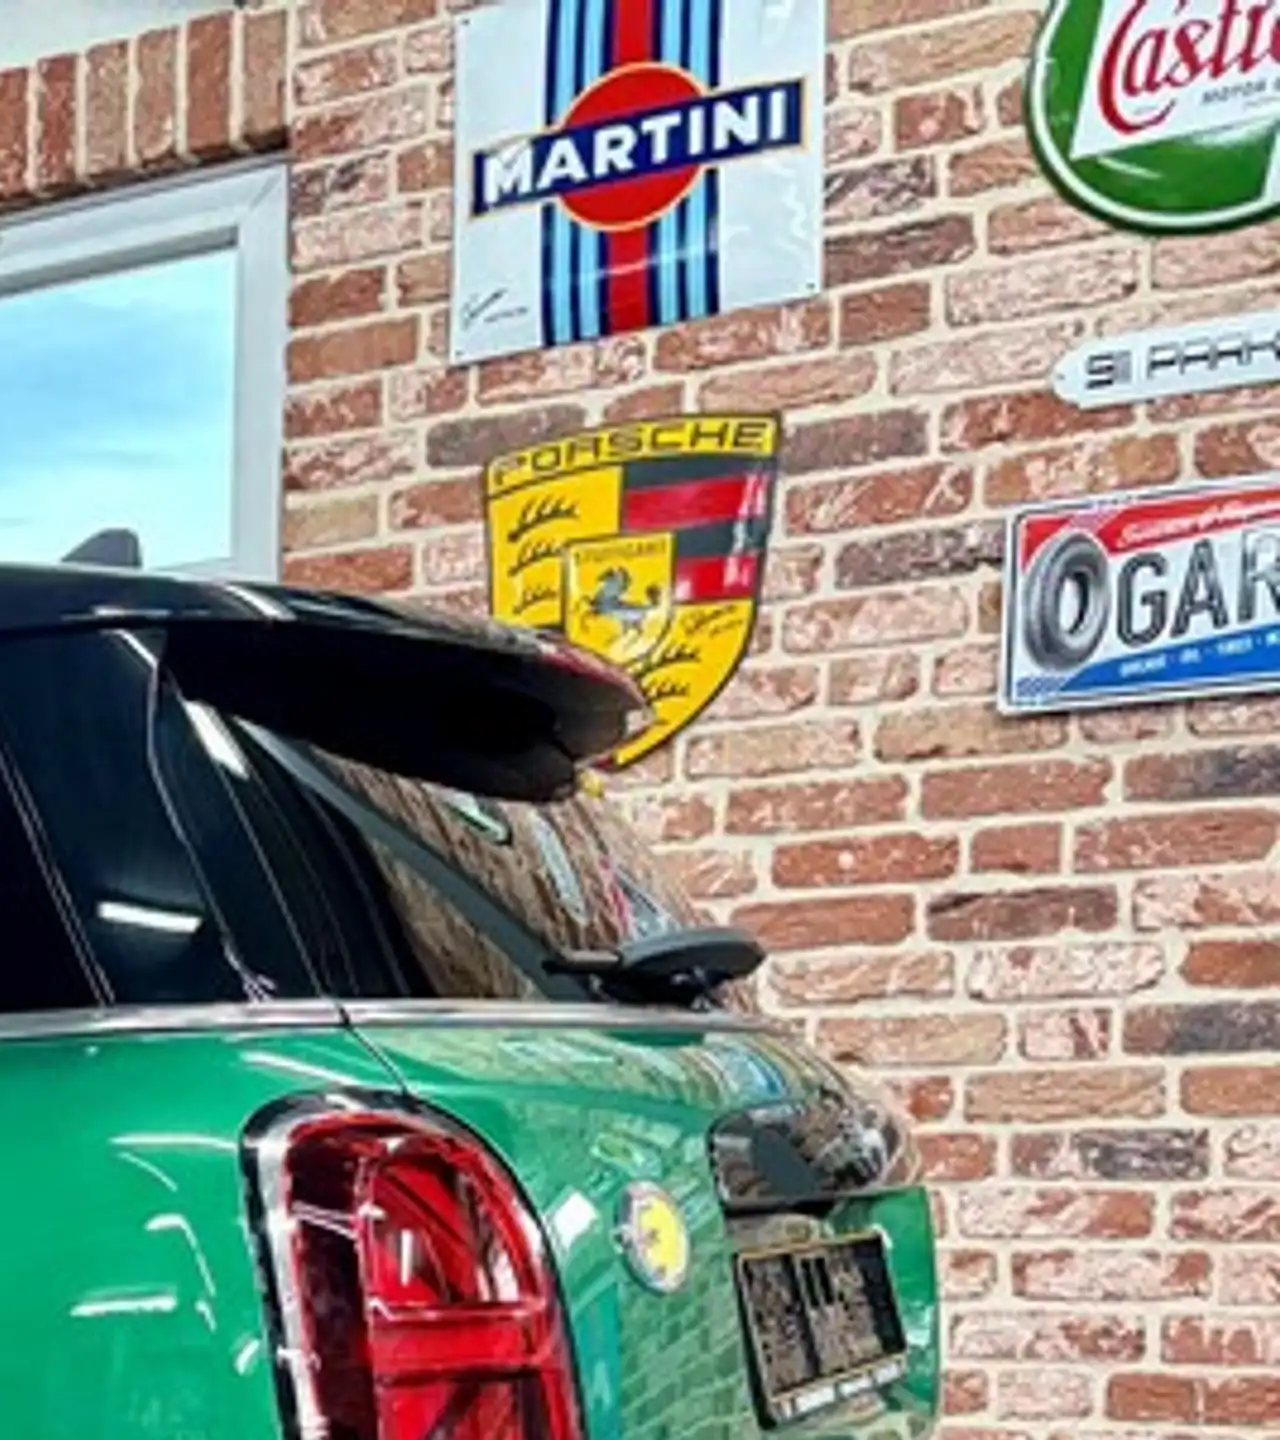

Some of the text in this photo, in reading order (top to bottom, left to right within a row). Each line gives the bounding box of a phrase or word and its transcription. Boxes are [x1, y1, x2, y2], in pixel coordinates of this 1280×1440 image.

[1098, 0, 1280, 131] Castr
[483, 90, 787, 205] MARTINI
[493, 422, 767, 486] PORSCHE
